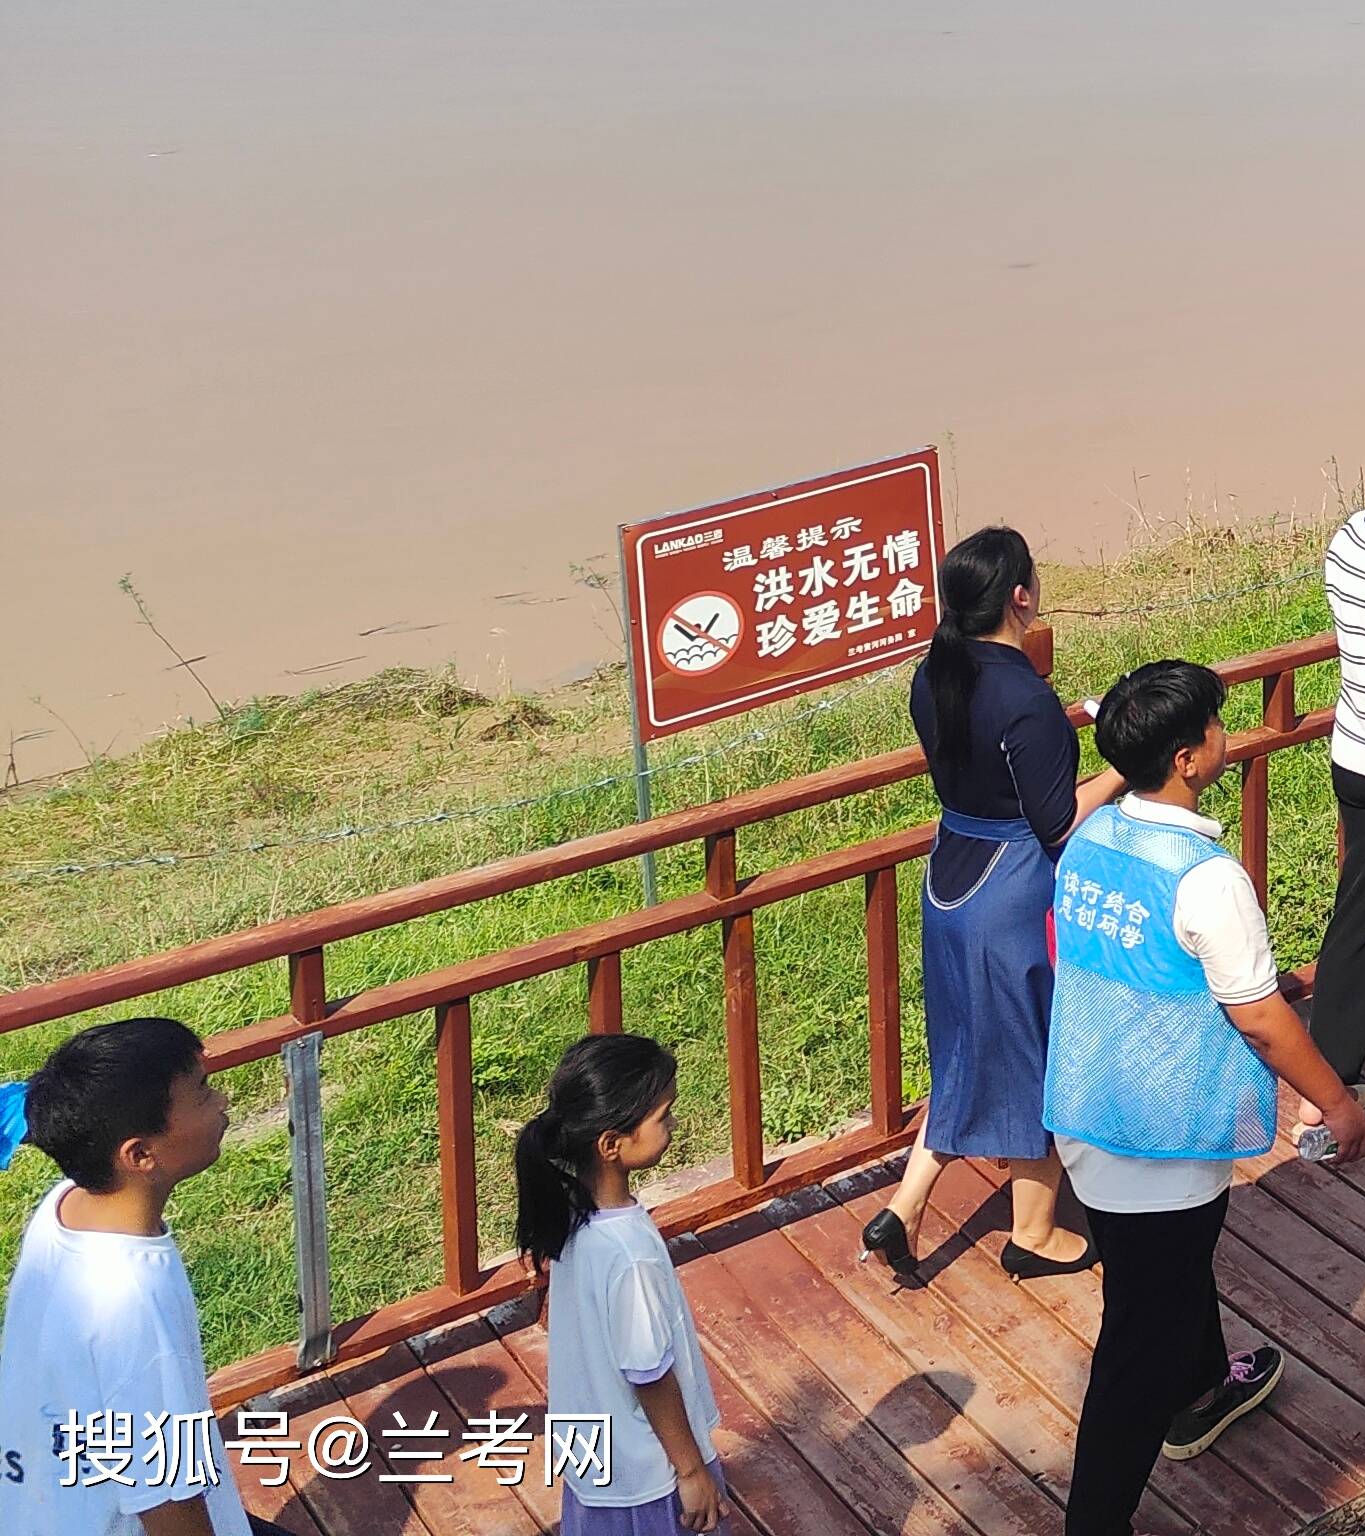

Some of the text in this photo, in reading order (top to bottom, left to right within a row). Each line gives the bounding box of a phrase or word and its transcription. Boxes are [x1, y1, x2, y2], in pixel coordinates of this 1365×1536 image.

[721, 516, 863, 572] 温馨提示
[752, 529, 921, 613] 洪水无情
[755, 577, 925, 659] 珍爱生命
[1058, 894, 1146, 950] 思创研学
[1063, 869, 1151, 925] 读行结合
